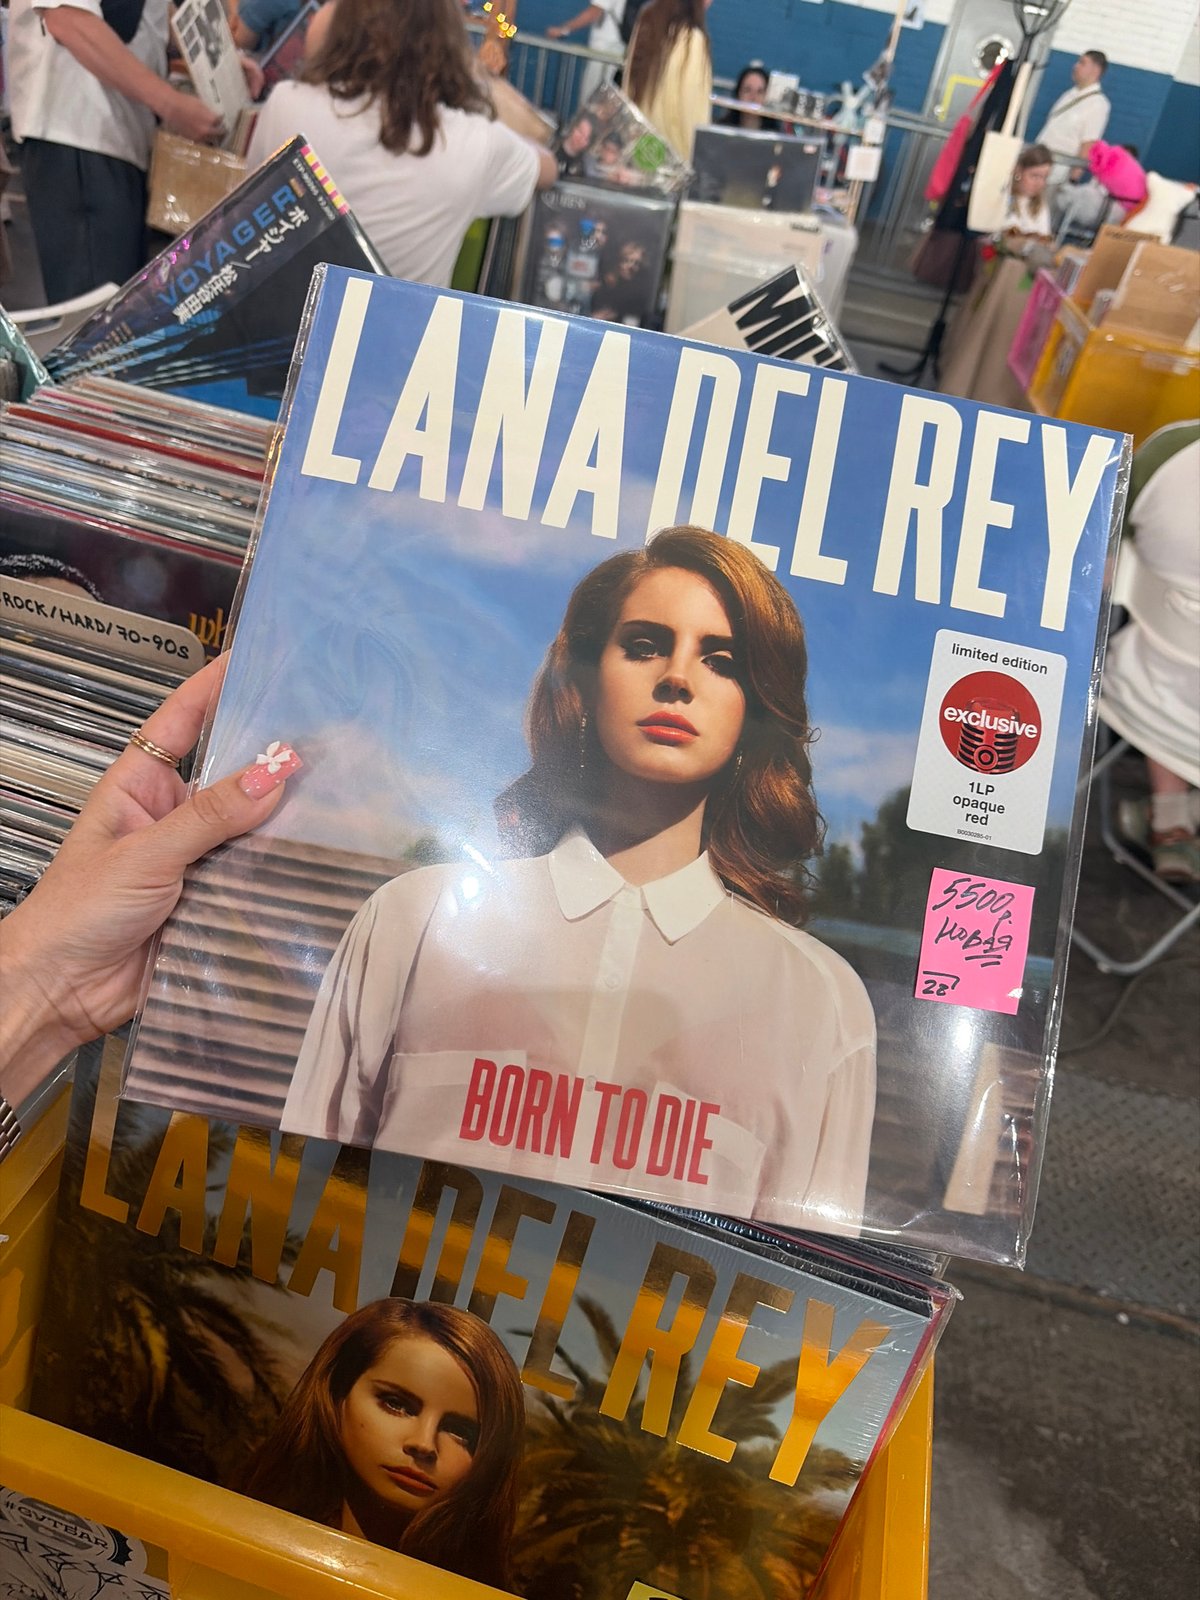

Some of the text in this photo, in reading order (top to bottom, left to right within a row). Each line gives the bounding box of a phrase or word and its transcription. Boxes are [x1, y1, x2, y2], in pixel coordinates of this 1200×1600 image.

[157, 184, 298, 306] VOYAGER
[301, 276, 1116, 632] LANA DEL REY
[951, 643, 1048, 675] limited edition
[943, 706, 1038, 739] exclusive
[952, 795, 1006, 815] opaque
[968, 781, 995, 797] 1LP
[965, 811, 989, 826] red
[459, 1057, 721, 1185] BORN TO DIE
[80, 1033, 890, 1488] LANA DEL REY
